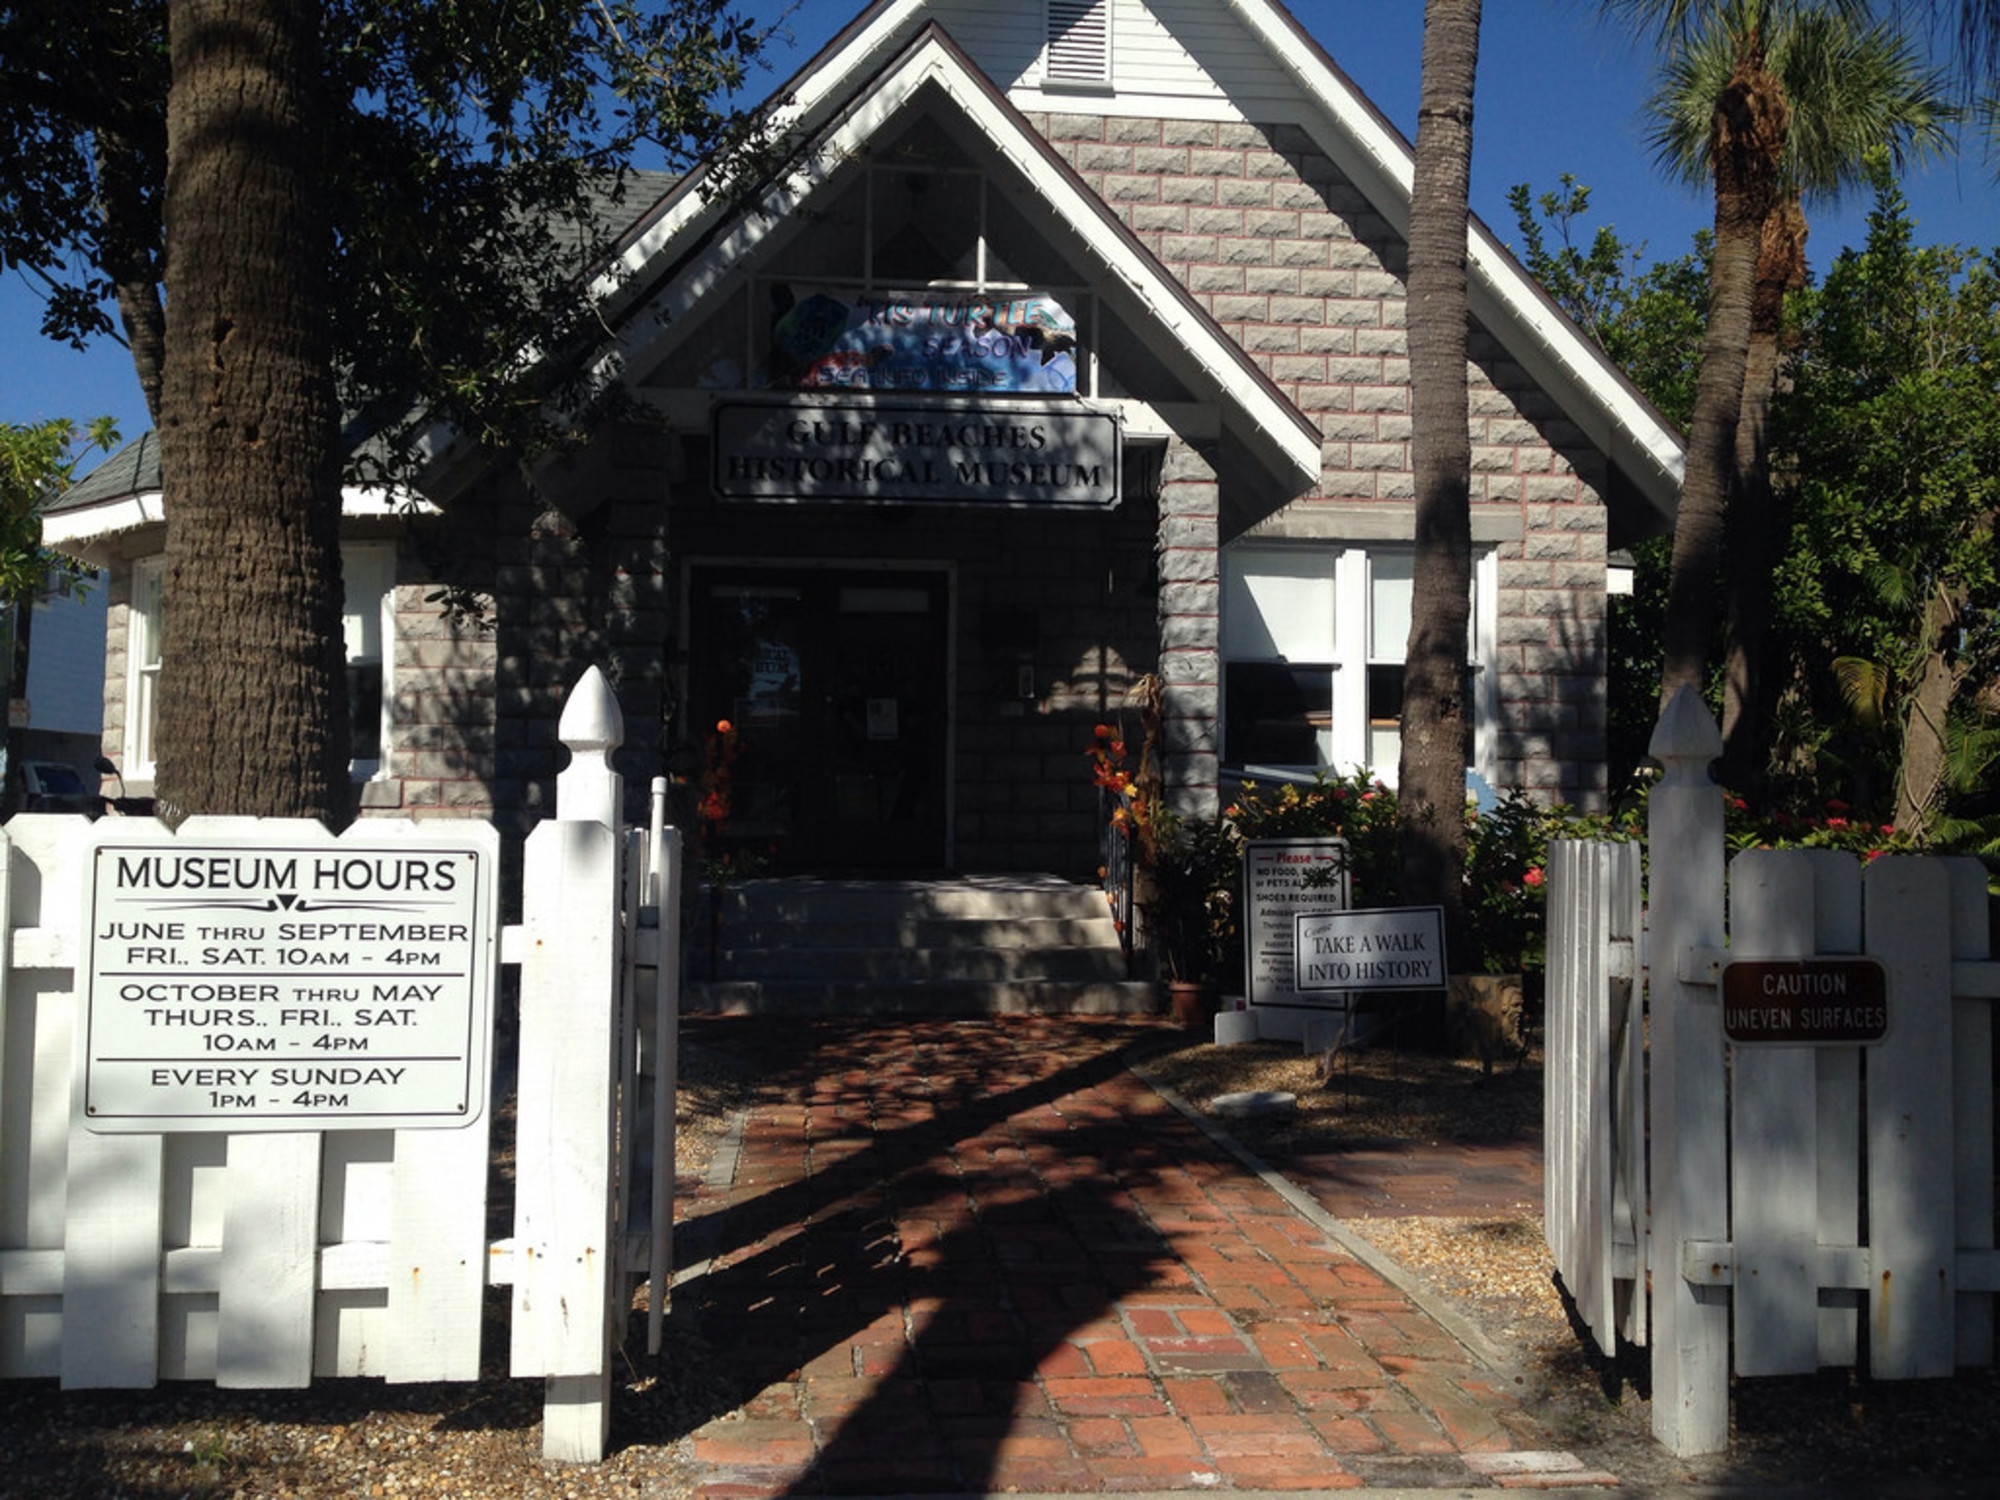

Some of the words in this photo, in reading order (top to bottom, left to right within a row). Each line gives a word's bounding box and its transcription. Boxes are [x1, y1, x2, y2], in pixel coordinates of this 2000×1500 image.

[925, 298, 1044, 328] TURTLE
[923, 333, 1033, 360] SEASON
[787, 419, 877, 446] GULF
[893, 422, 1047, 451] BEACHES
[728, 456, 940, 486] HISTORICAL
[955, 459, 1103, 488] MUSEUM
[1276, 852, 1312, 864] Please
[116, 856, 298, 890] MUSEUM
[313, 858, 456, 892] HOURS
[1267, 879, 1289, 888] PETS
[1256, 893, 1287, 903] SHOES
[1289, 893, 1337, 903] REQUIRED
[99, 922, 185, 940] JUNE
[198, 927, 265, 941] THRU
[278, 923, 468, 942] SEPTEMBER
[1313, 935, 1356, 955] TAKE
[1360, 935, 1372, 954] A
[1375, 933, 1426, 953] WALK
[202, 947, 266, 966] SAT.
[276, 947, 349, 966] 10AM
[385, 948, 441, 965] 4PM
[1308, 962, 1350, 982] INTO
[1356, 960, 1433, 981] HISTORY
[119, 983, 279, 1002] OCTOBER
[293, 988, 360, 1002] THRU
[372, 984, 443, 1002] MAY
[1762, 973, 1847, 995] CAUTION
[354, 1008, 417, 1027] SAT.
[1726, 1007, 1792, 1030] UNEVEN
[1800, 1007, 1885, 1029] SURFACES
[203, 1033, 276, 1052] 10AM
[312, 1033, 369, 1051] 4PM
[151, 1068, 259, 1087] EVERY
[270, 1067, 406, 1087] SUNDAY
[209, 1090, 256, 1108] 1PM
[292, 1090, 349, 1107] 4PM
